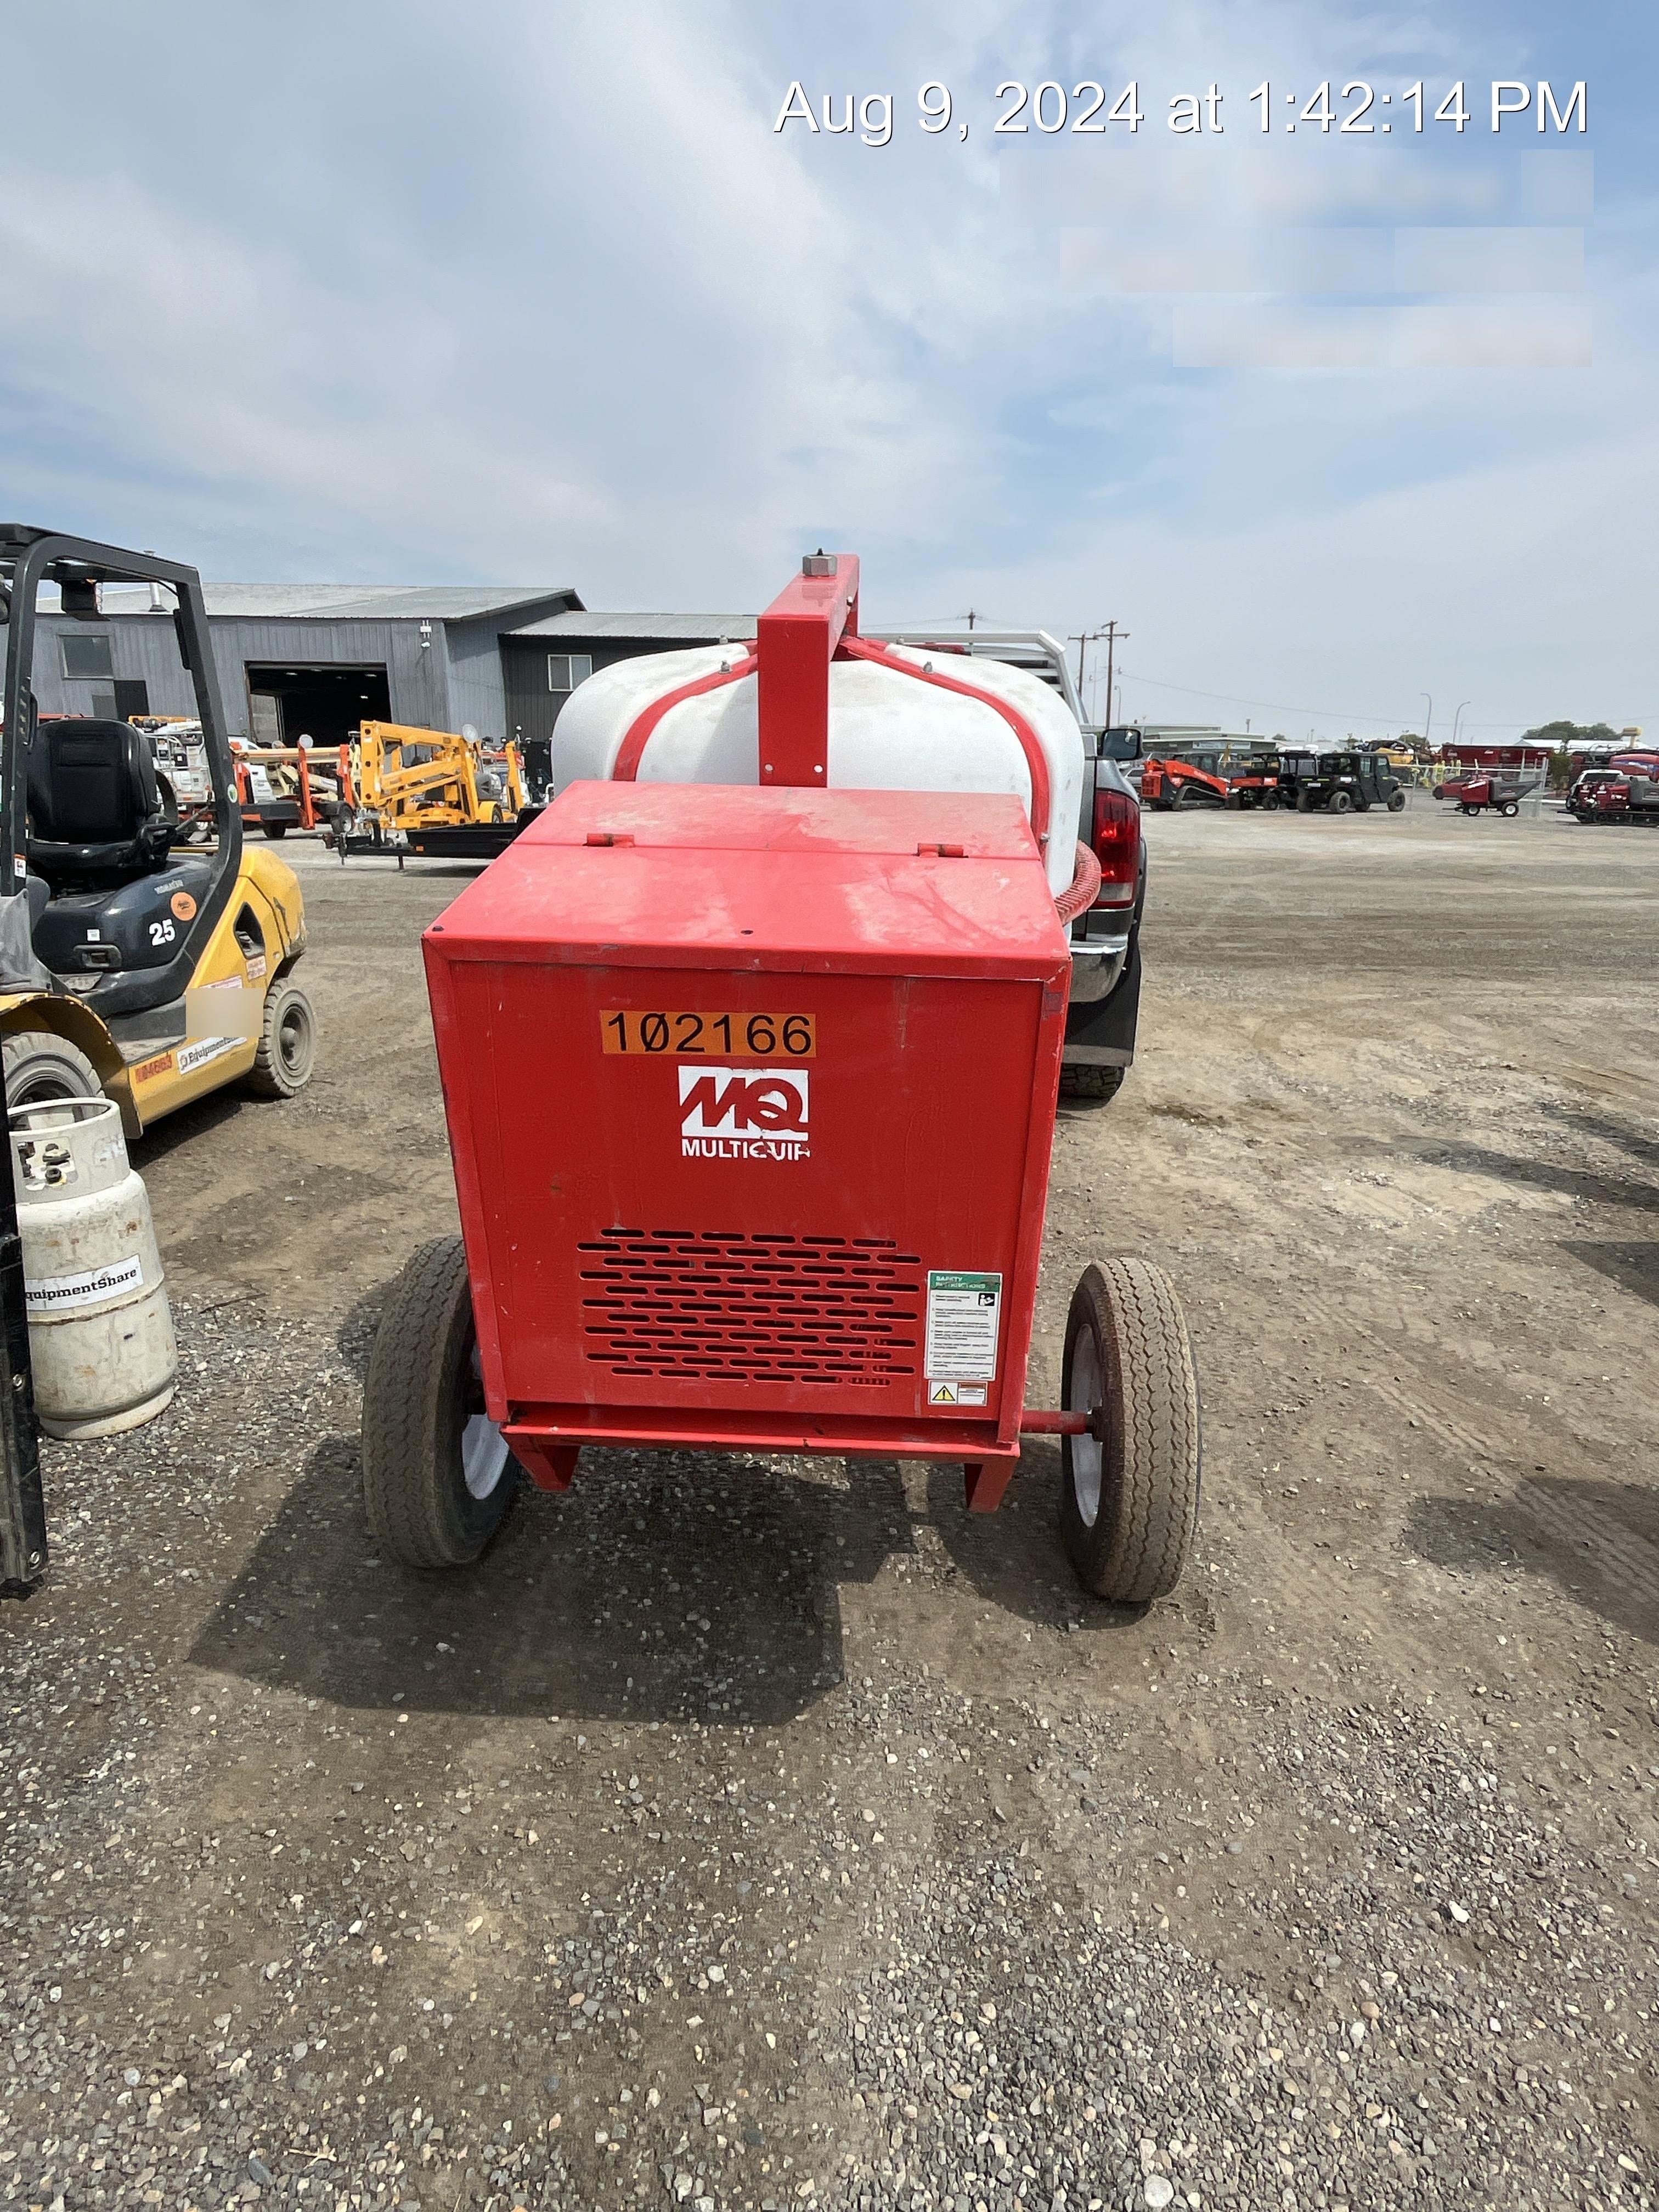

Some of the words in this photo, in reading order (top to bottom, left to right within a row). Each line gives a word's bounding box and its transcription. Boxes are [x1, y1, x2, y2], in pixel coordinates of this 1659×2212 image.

[149, 918, 176, 946] 25
[608, 1012, 812, 1054] 102166
[680, 1073, 809, 1132] MQ
[25, 1269, 137, 1301] quipmentShare
